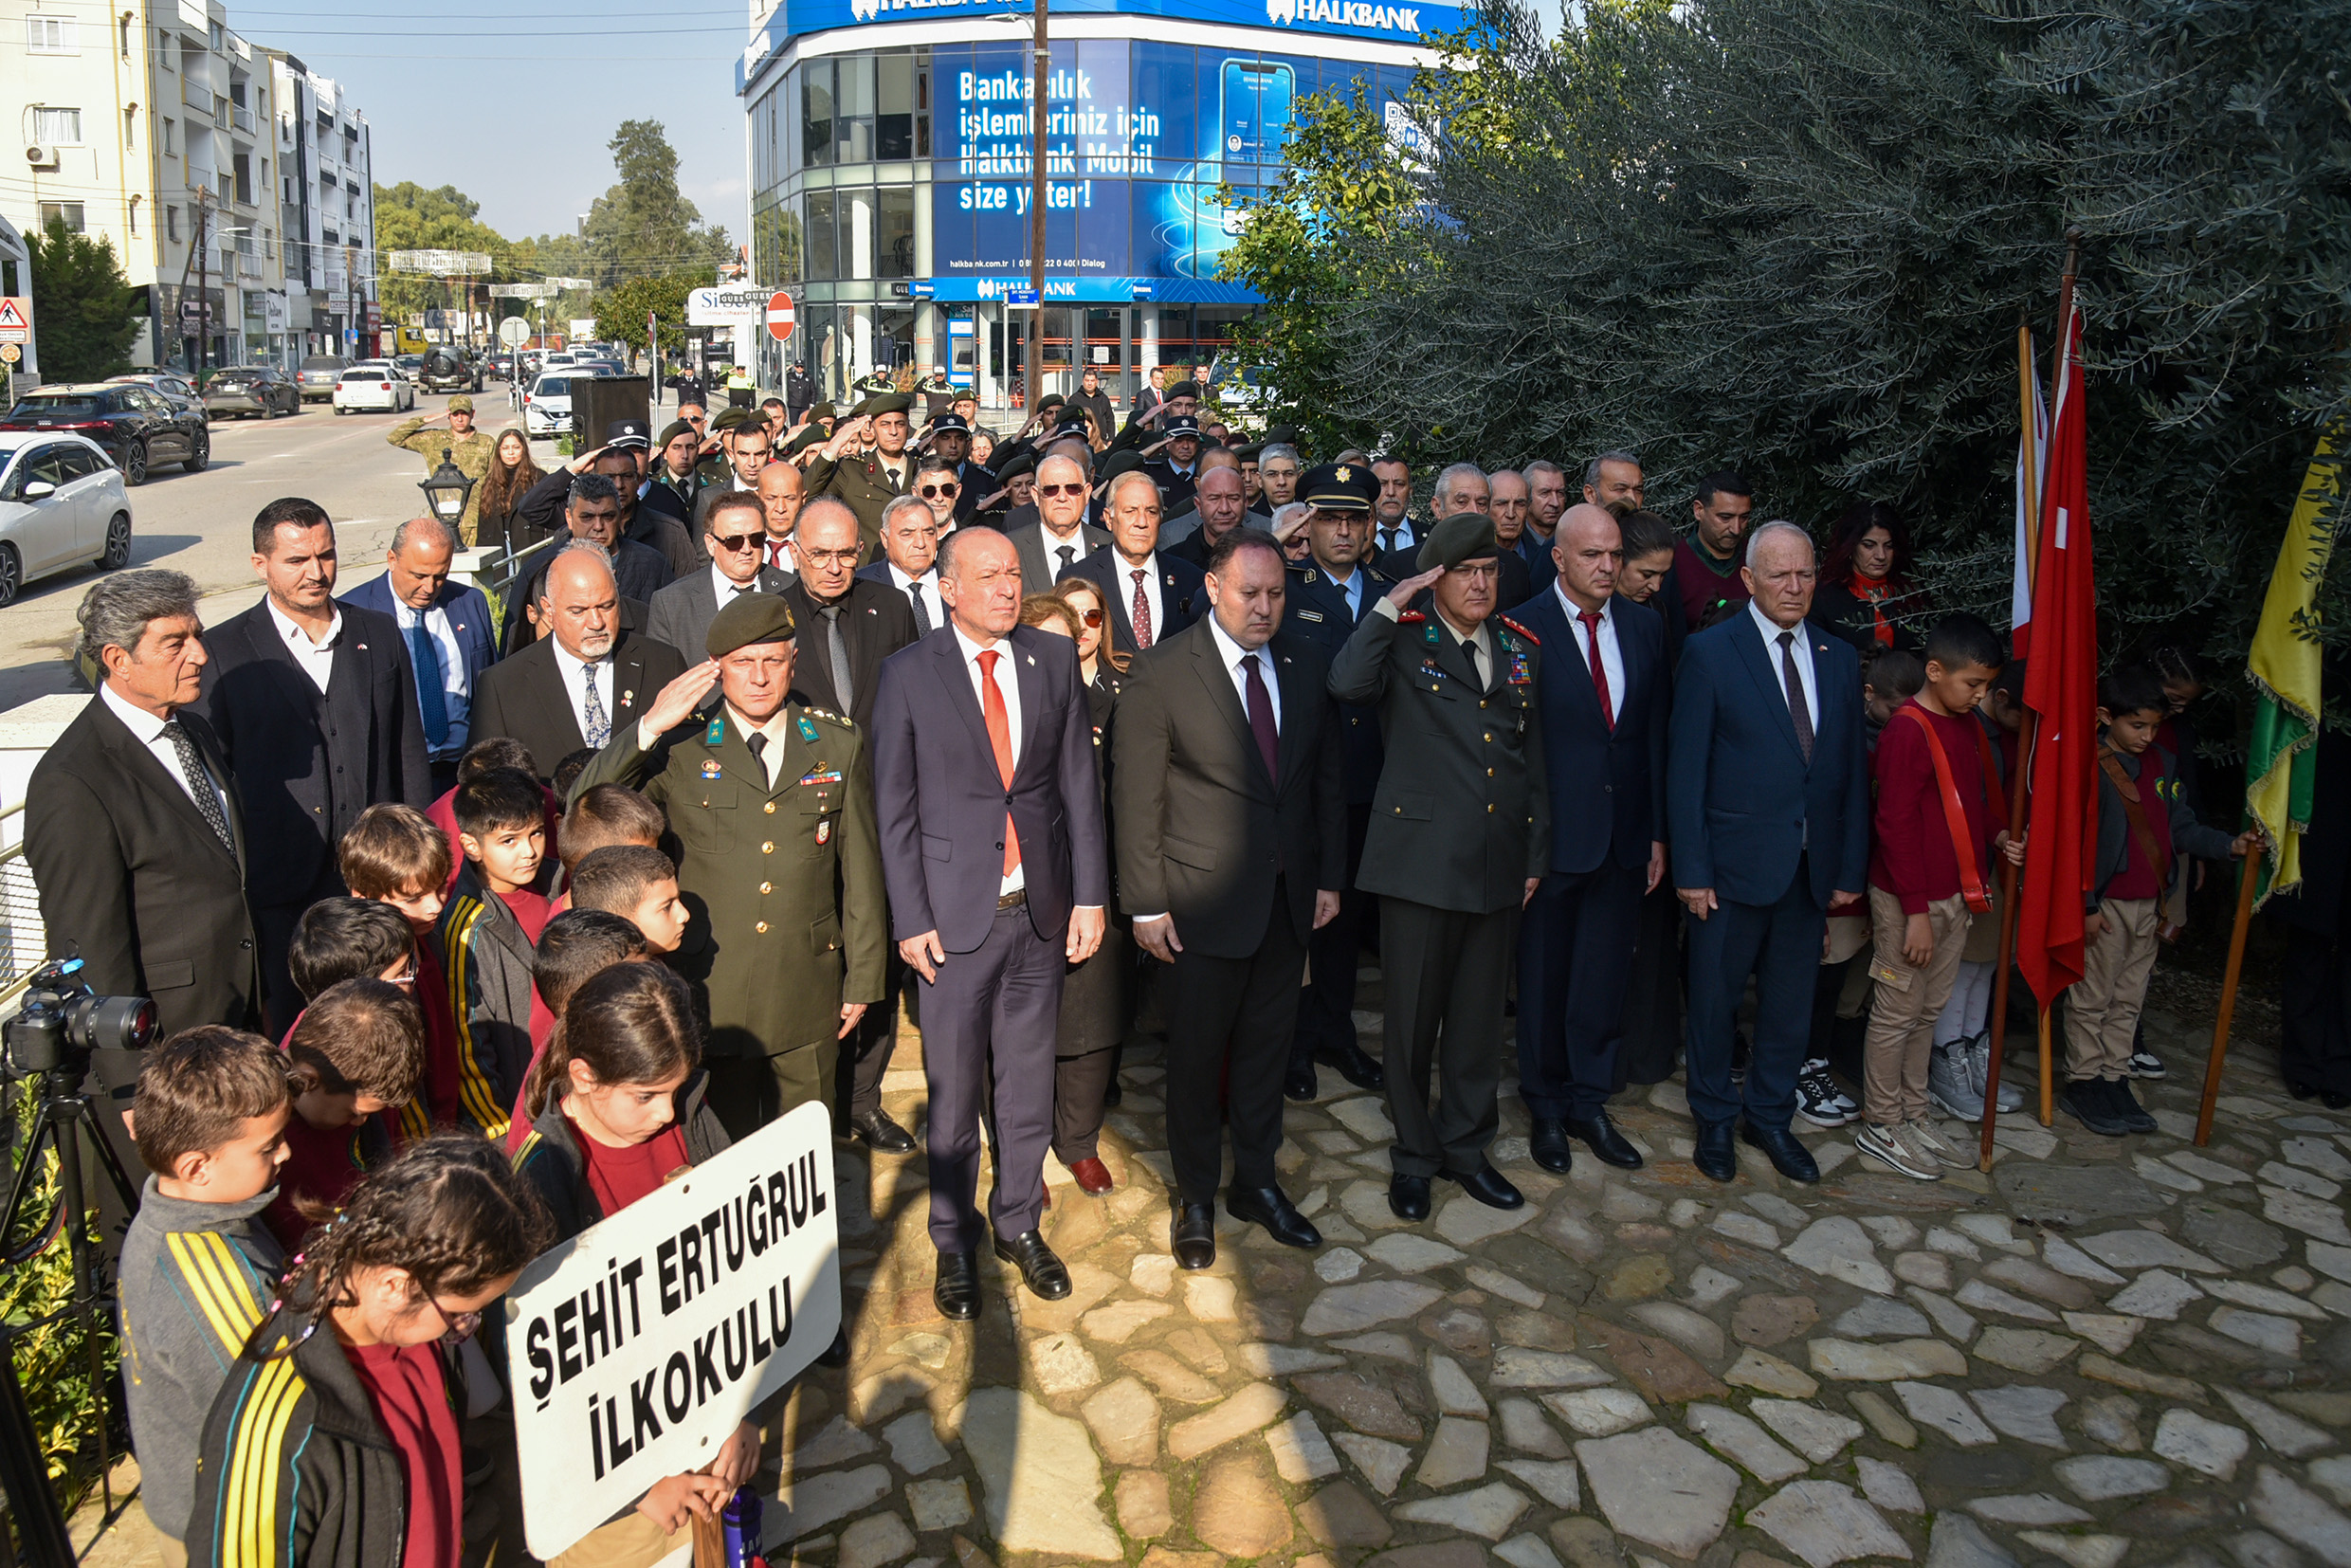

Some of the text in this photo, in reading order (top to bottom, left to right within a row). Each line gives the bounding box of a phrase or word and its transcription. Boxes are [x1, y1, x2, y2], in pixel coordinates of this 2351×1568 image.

[1297, 0, 1420, 32] HALKBANK
[960, 69, 1091, 100] Bankaılık
[1117, 106, 1159, 141] için
[960, 142, 1154, 174] Halkbnk Mobil
[960, 179, 1091, 215] size yter!
[1082, 259, 1105, 268] Dialog
[745, 292, 774, 301] GUES
[527, 1149, 827, 1413] ŞEHİT ERTUĞRUL
[588, 1275, 793, 1483] İLKOKULU
